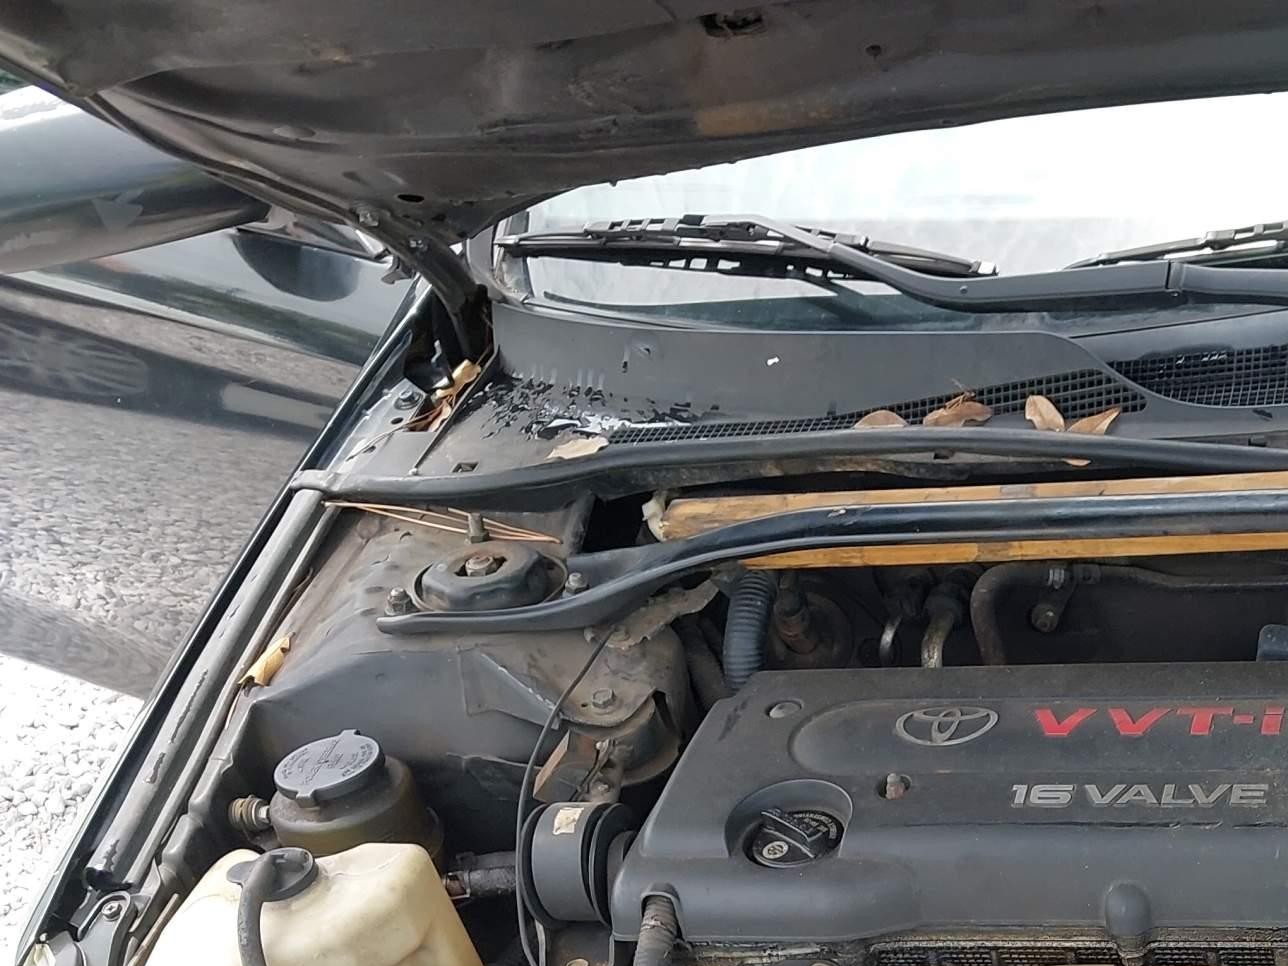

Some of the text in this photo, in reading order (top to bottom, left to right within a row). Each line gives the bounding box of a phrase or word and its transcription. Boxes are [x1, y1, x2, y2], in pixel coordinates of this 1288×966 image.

[1034, 706, 1286, 737] VVT-i
[1011, 783, 1270, 807] 16 VALVE
